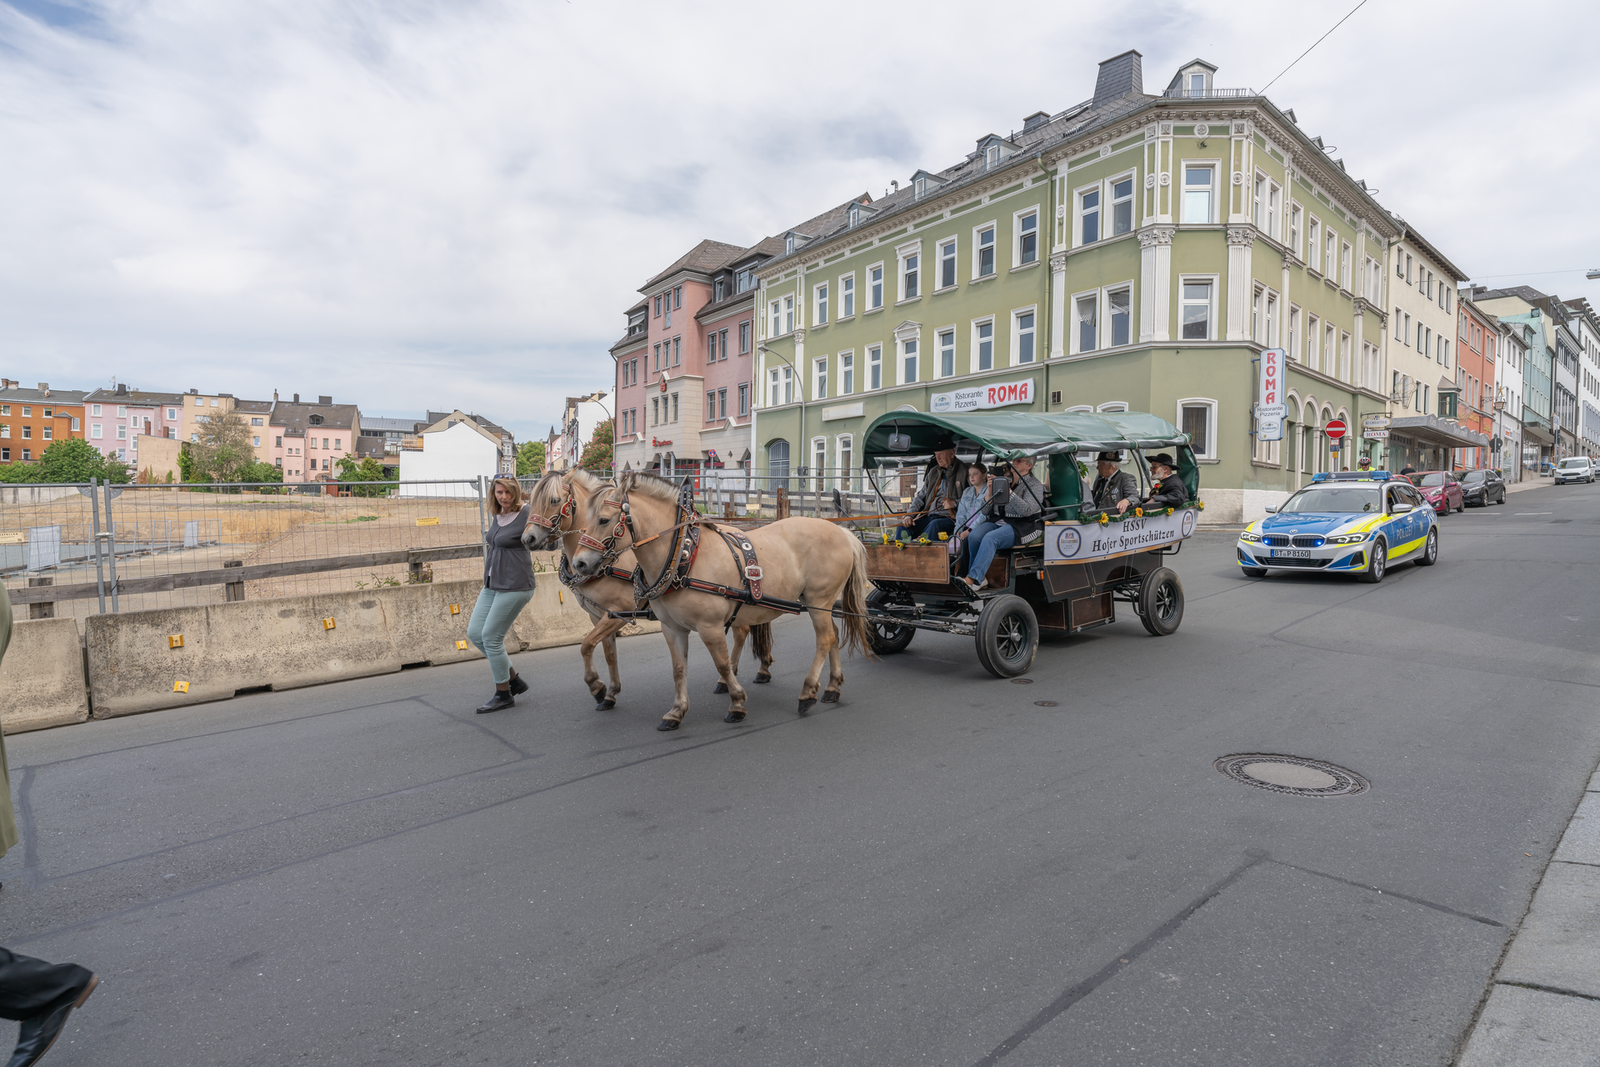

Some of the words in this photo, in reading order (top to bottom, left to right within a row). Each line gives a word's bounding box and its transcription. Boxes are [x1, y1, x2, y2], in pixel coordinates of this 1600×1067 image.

[1265, 352, 1276, 405] ROMA
[955, 390, 984, 401] Ristorante
[988, 383, 1028, 405] ROMA
[954, 399, 977, 409] Pizzeria
[1122, 518, 1148, 532] HSSV
[1396, 526, 1412, 541] POLIZEI
[1092, 537, 1117, 554] Hofer
[1119, 529, 1175, 550] Sportschützen
